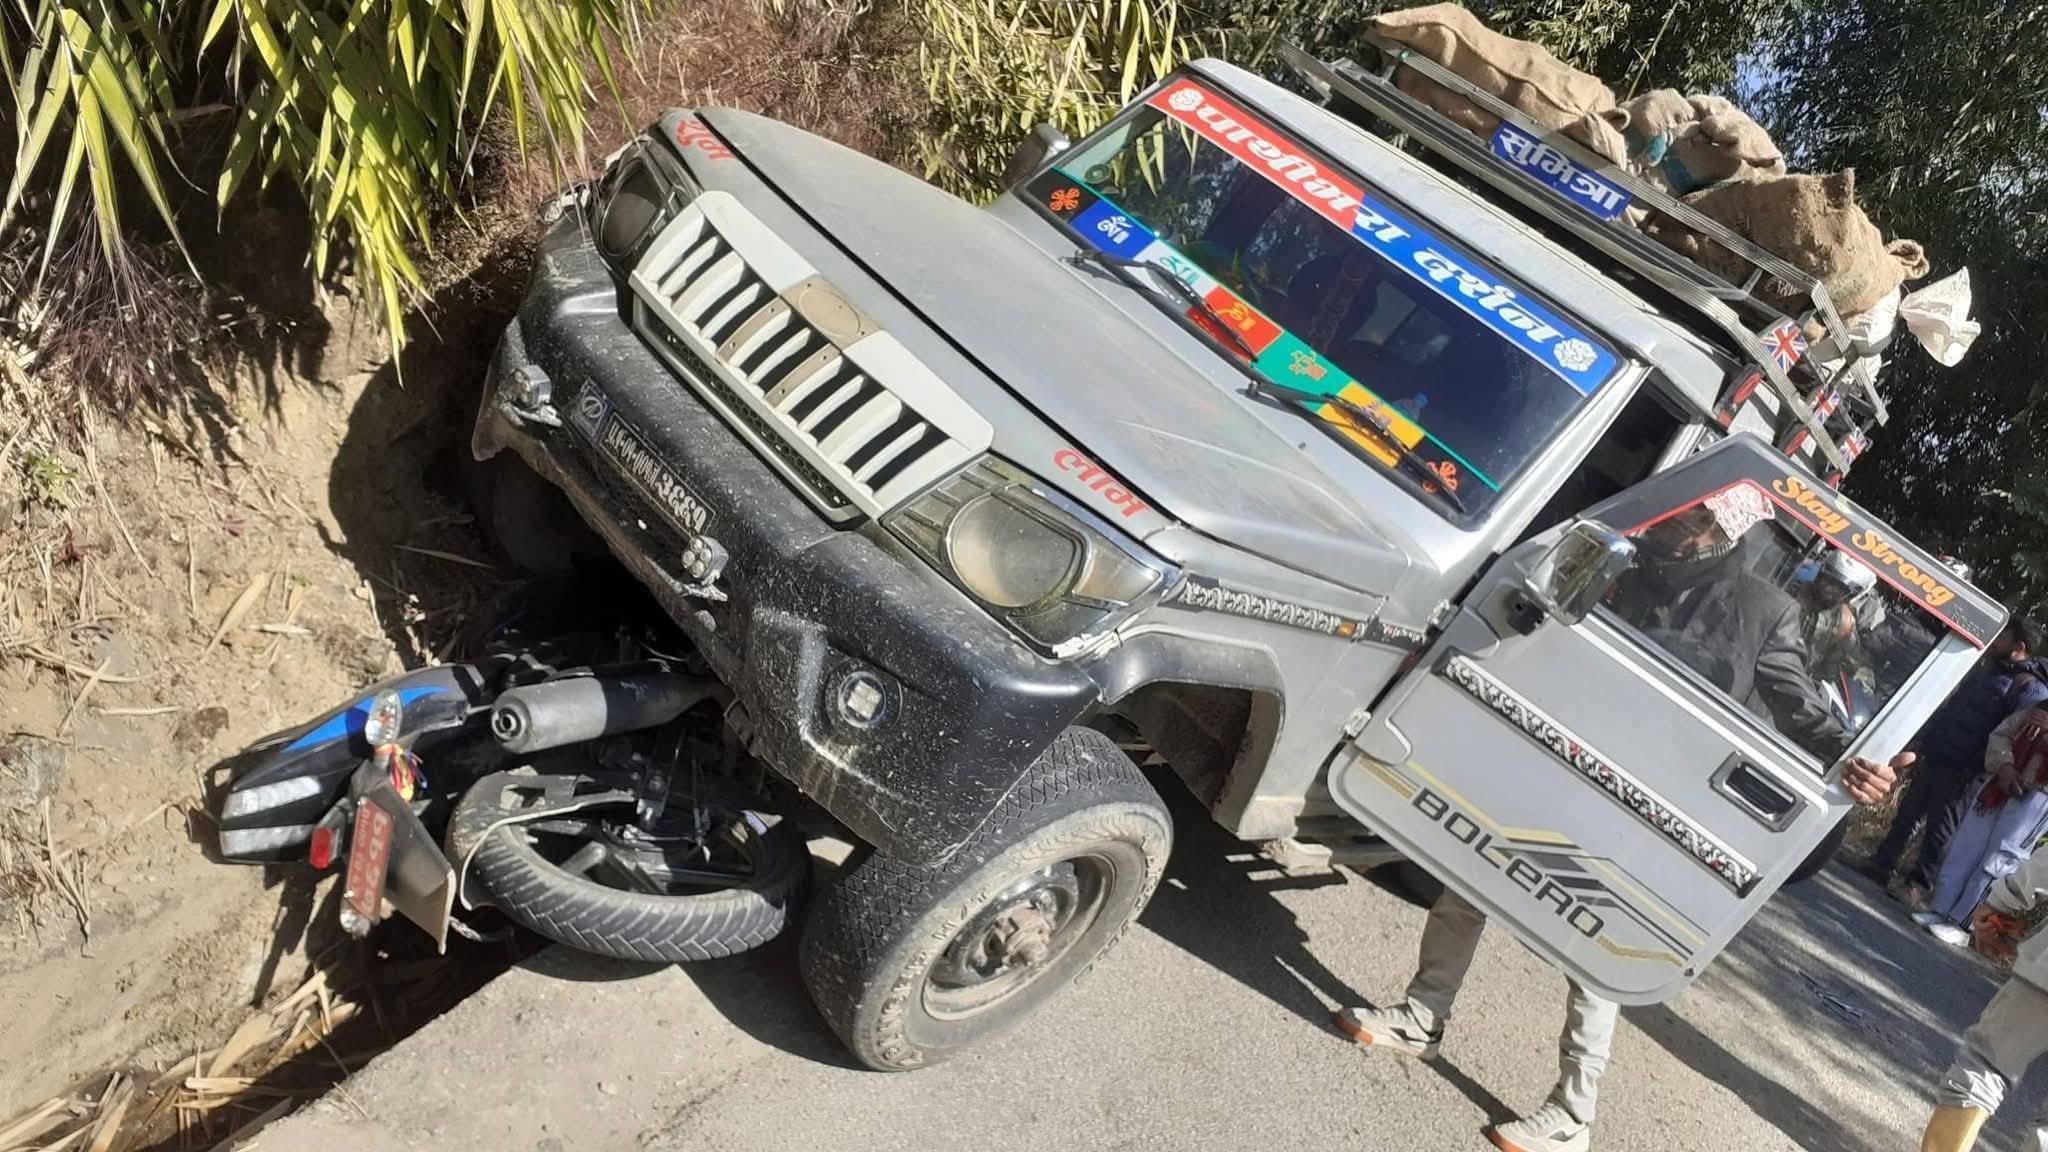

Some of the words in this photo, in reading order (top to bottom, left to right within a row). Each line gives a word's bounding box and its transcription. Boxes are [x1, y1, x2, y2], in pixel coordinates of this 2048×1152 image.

[1195, 104, 1411, 244] पाथीभरा
[1413, 247, 1566, 345] दर्शन
[1772, 475, 1850, 534] Stay
[1852, 529, 1956, 606] Strong
